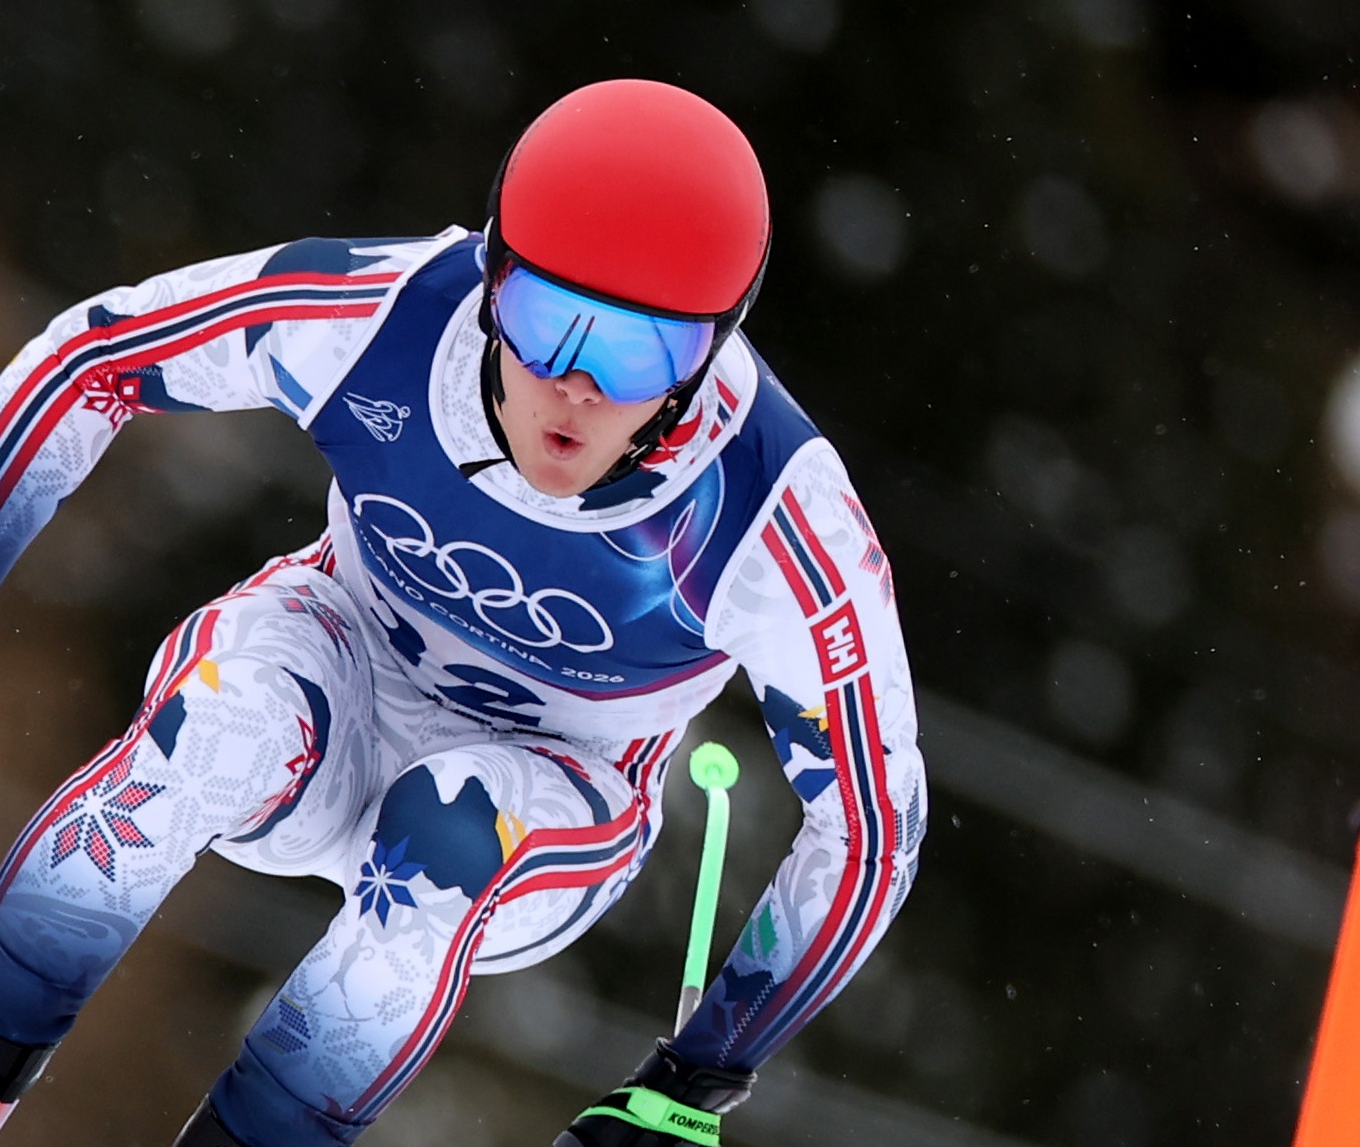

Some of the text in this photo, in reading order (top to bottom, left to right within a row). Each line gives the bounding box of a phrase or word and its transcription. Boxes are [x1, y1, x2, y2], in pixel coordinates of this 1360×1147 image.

[354, 518, 626, 683] LANO CORTINA 2026
